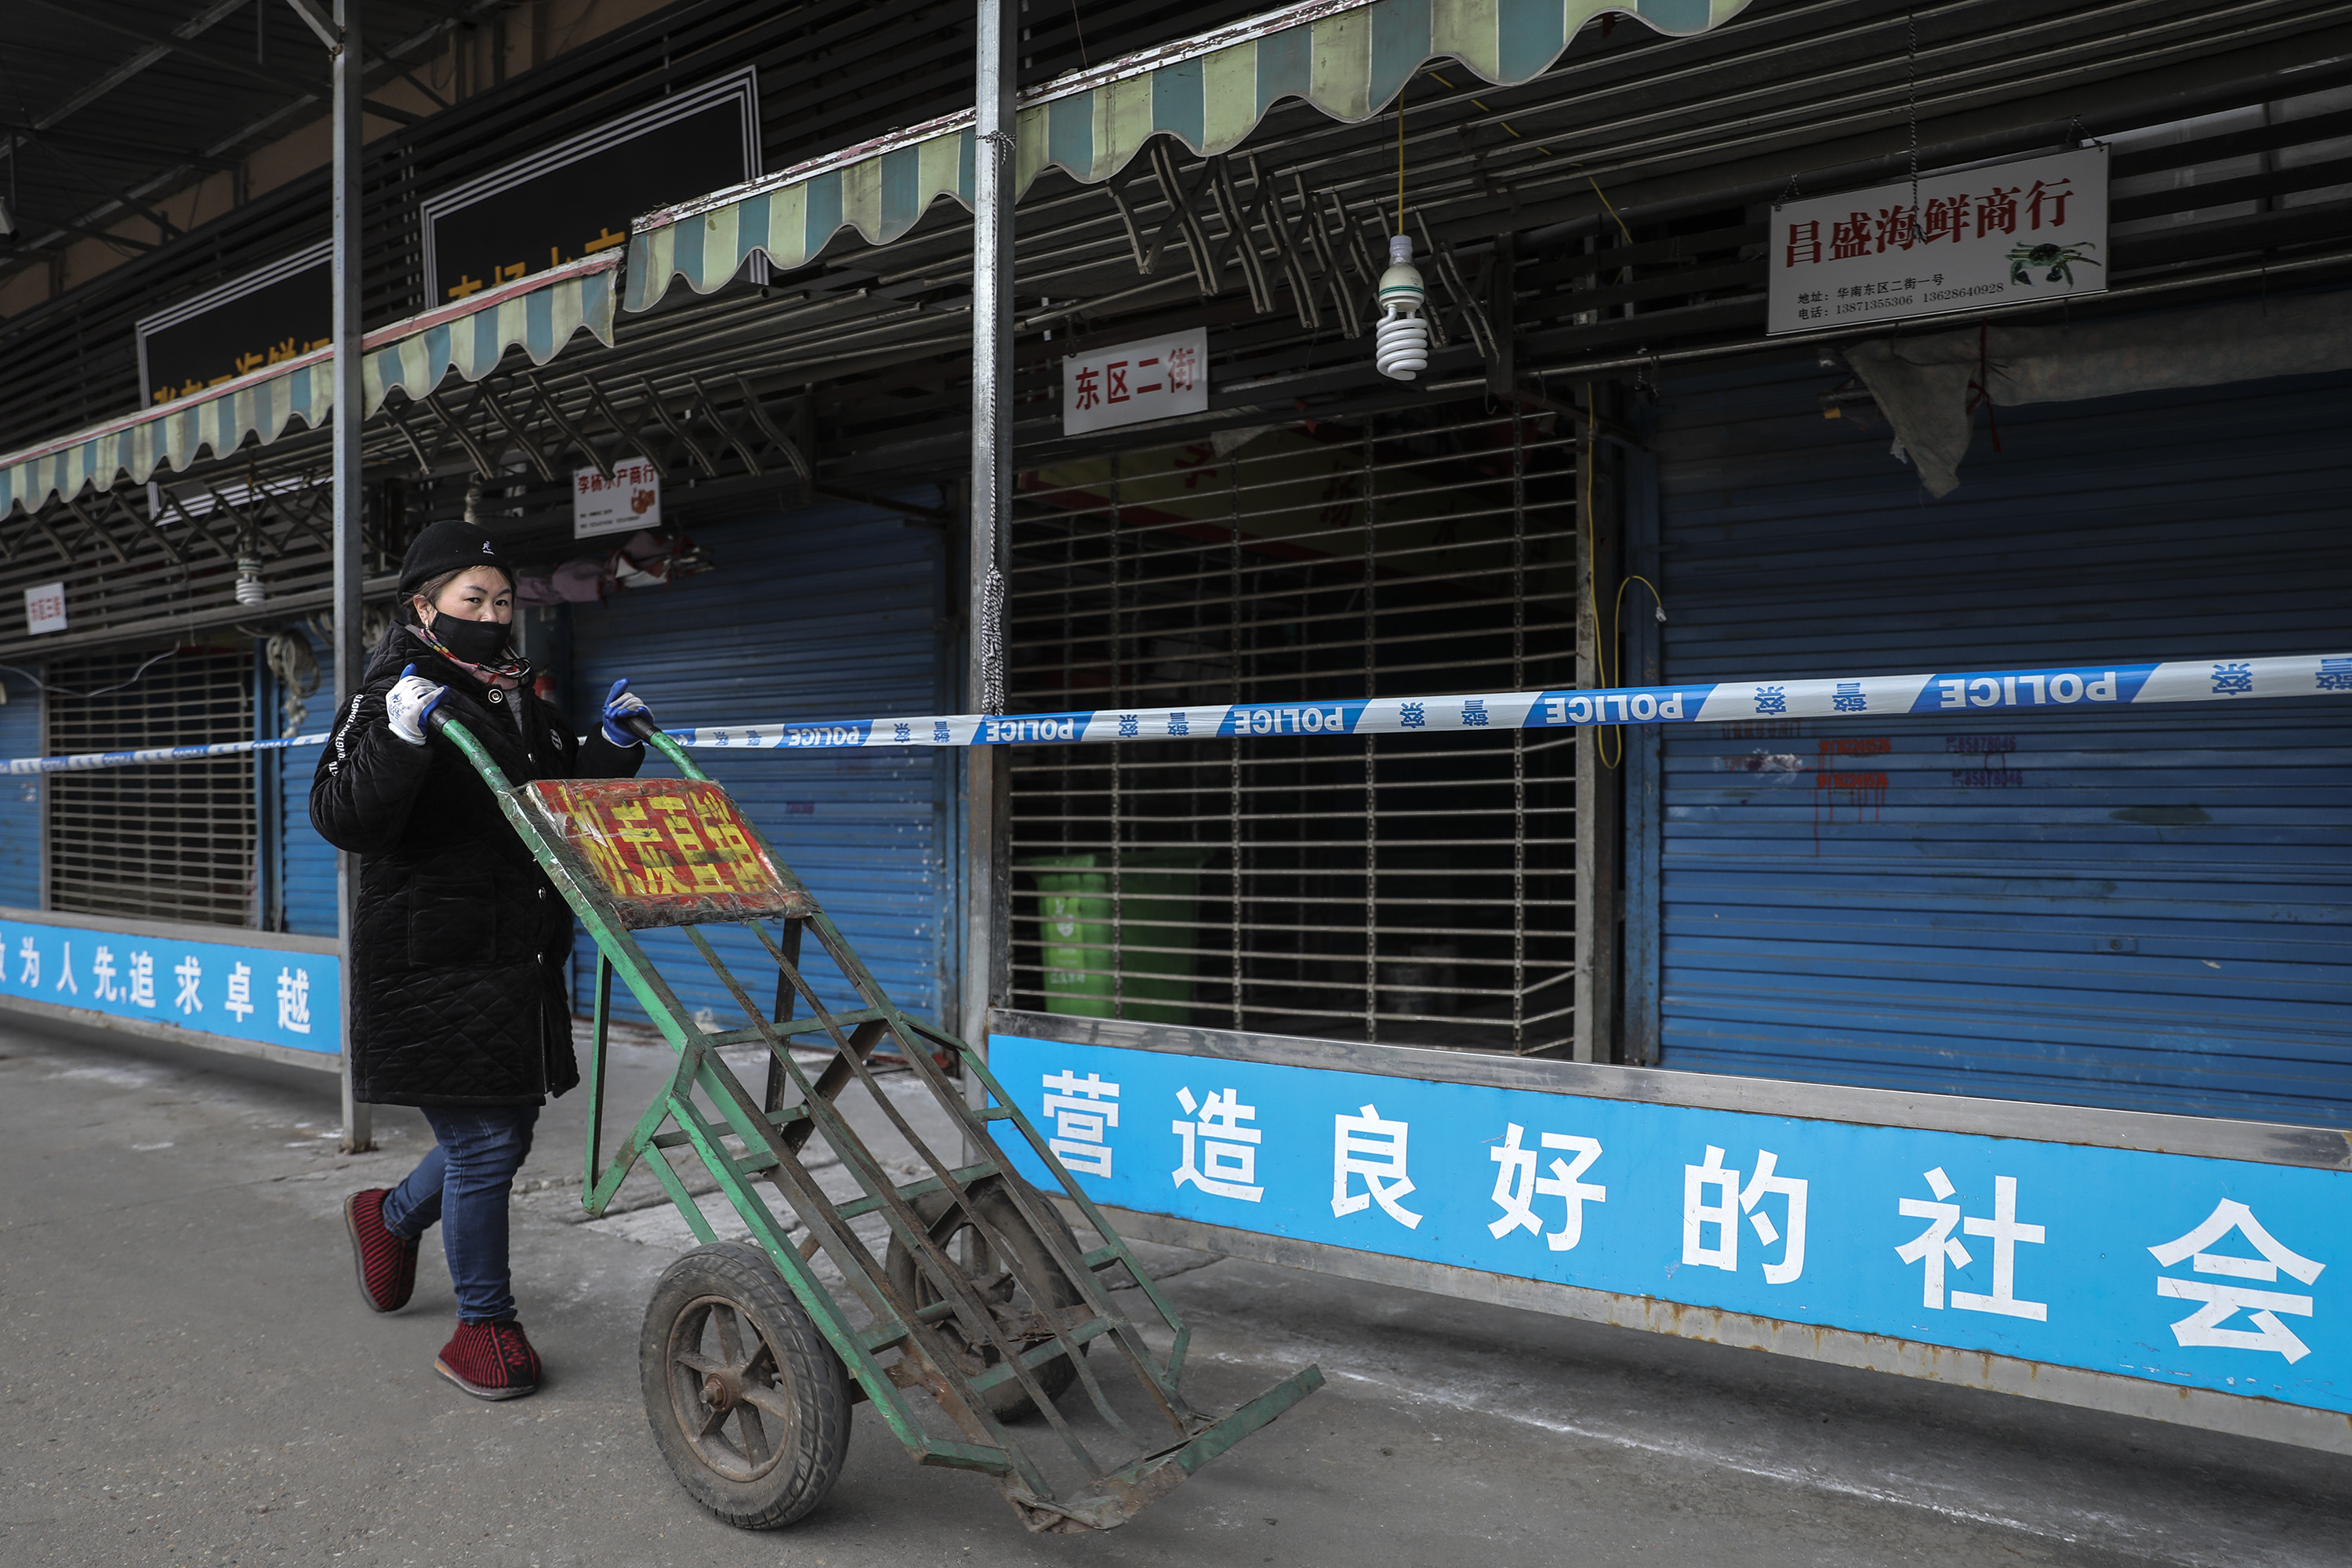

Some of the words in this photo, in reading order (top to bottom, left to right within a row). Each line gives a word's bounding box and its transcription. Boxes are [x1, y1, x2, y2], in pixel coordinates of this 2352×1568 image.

[1786, 178, 2074, 267] 昌盛海鲜商行
[1923, 282, 2005, 303] 13628640928
[1076, 348, 1196, 410] 东区二街
[1939, 671, 2117, 708] POLICE
[2212, 658, 2352, 696] 警察
[1400, 699, 1489, 728] 警察
[1545, 691, 1684, 724] POLICE
[1755, 682, 1867, 716] 警察
[787, 727, 860, 746] POLICE
[986, 718, 1074, 742] POLICE
[1118, 712, 1189, 738] 警察
[1235, 706, 1345, 735] POLICE
[0, 933, 311, 1035] 为人先，追求卓越
[1040, 1069, 2326, 1365] 营造良好的社会
